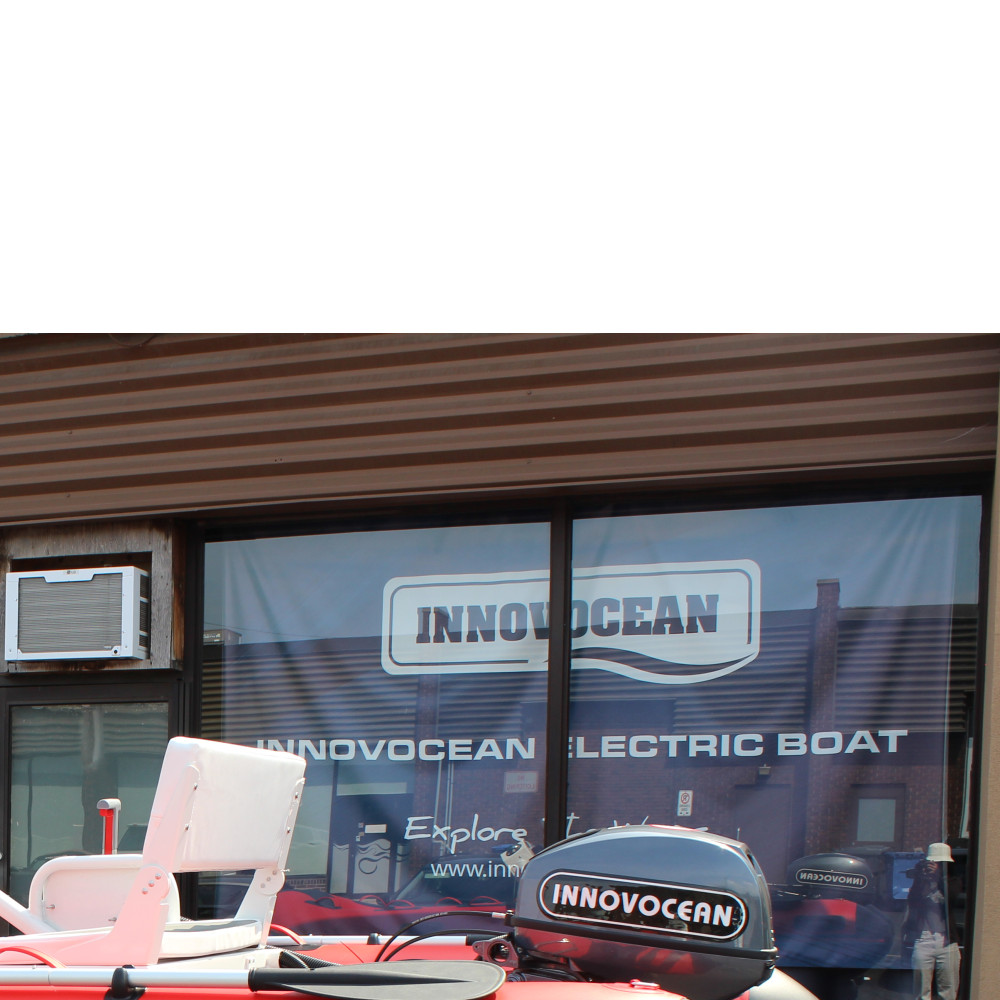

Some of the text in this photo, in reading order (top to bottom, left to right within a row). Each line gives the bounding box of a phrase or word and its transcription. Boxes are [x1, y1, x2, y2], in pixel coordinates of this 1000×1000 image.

[416, 594, 719, 643] INNOVOCEAN
[777, 730, 908, 756] BOAT
[404, 814, 528, 854] Explore
[430, 860, 524, 878] www.inn
[552, 883, 733, 927] INNOVOCEAN
